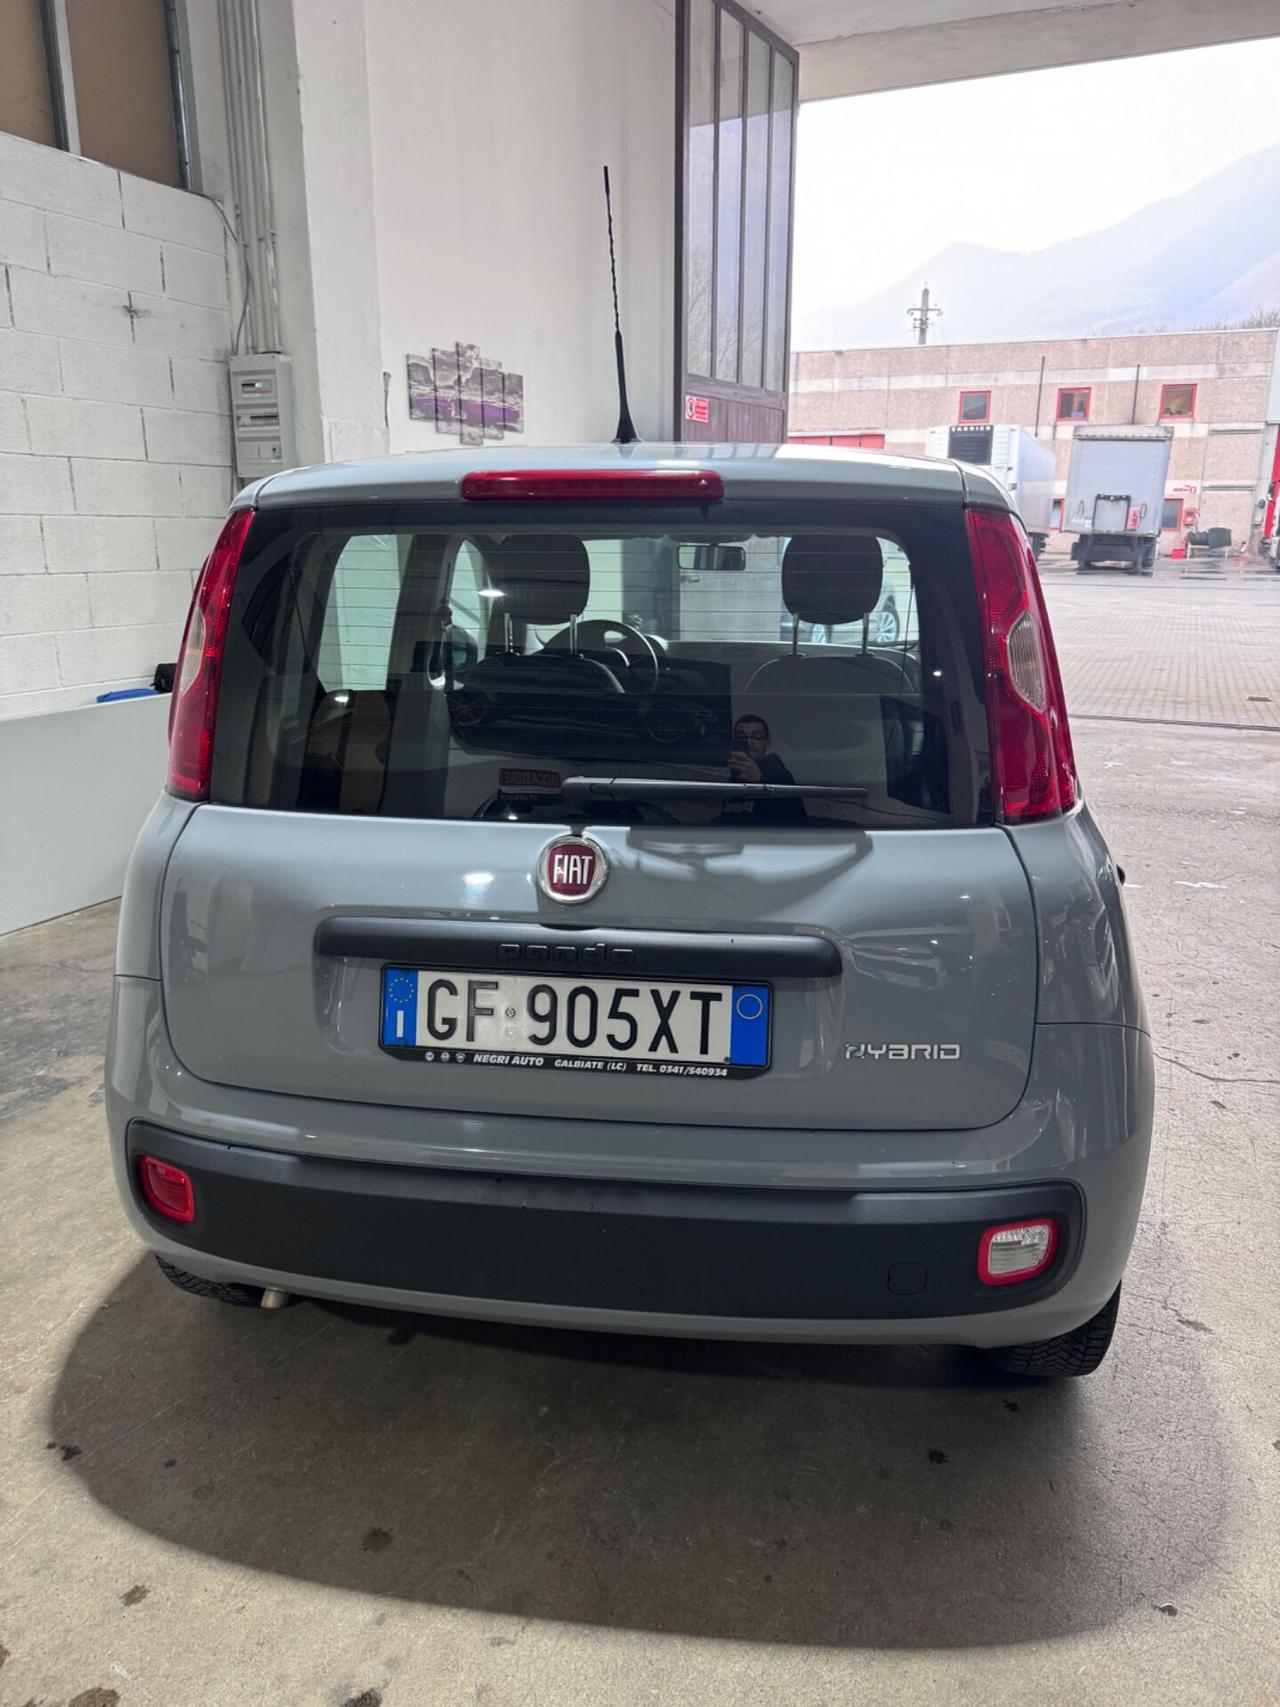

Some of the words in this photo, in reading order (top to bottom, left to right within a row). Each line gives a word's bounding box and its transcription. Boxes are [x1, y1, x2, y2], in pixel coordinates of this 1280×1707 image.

[552, 854, 593, 885] FIAT
[498, 942, 637, 966] panda
[426, 978, 499, 1042] GF
[526, 984, 723, 1055] 905XT
[845, 1043, 961, 1060] HYBRID
[473, 1054, 510, 1064] NEGRI
[511, 1056, 544, 1067] AUTO
[554, 1059, 604, 1069] GALBIATE
[607, 1062, 627, 1072] (LC)
[636, 1063, 657, 1072] TEL.
[660, 1065, 728, 1077] 0341/540934
